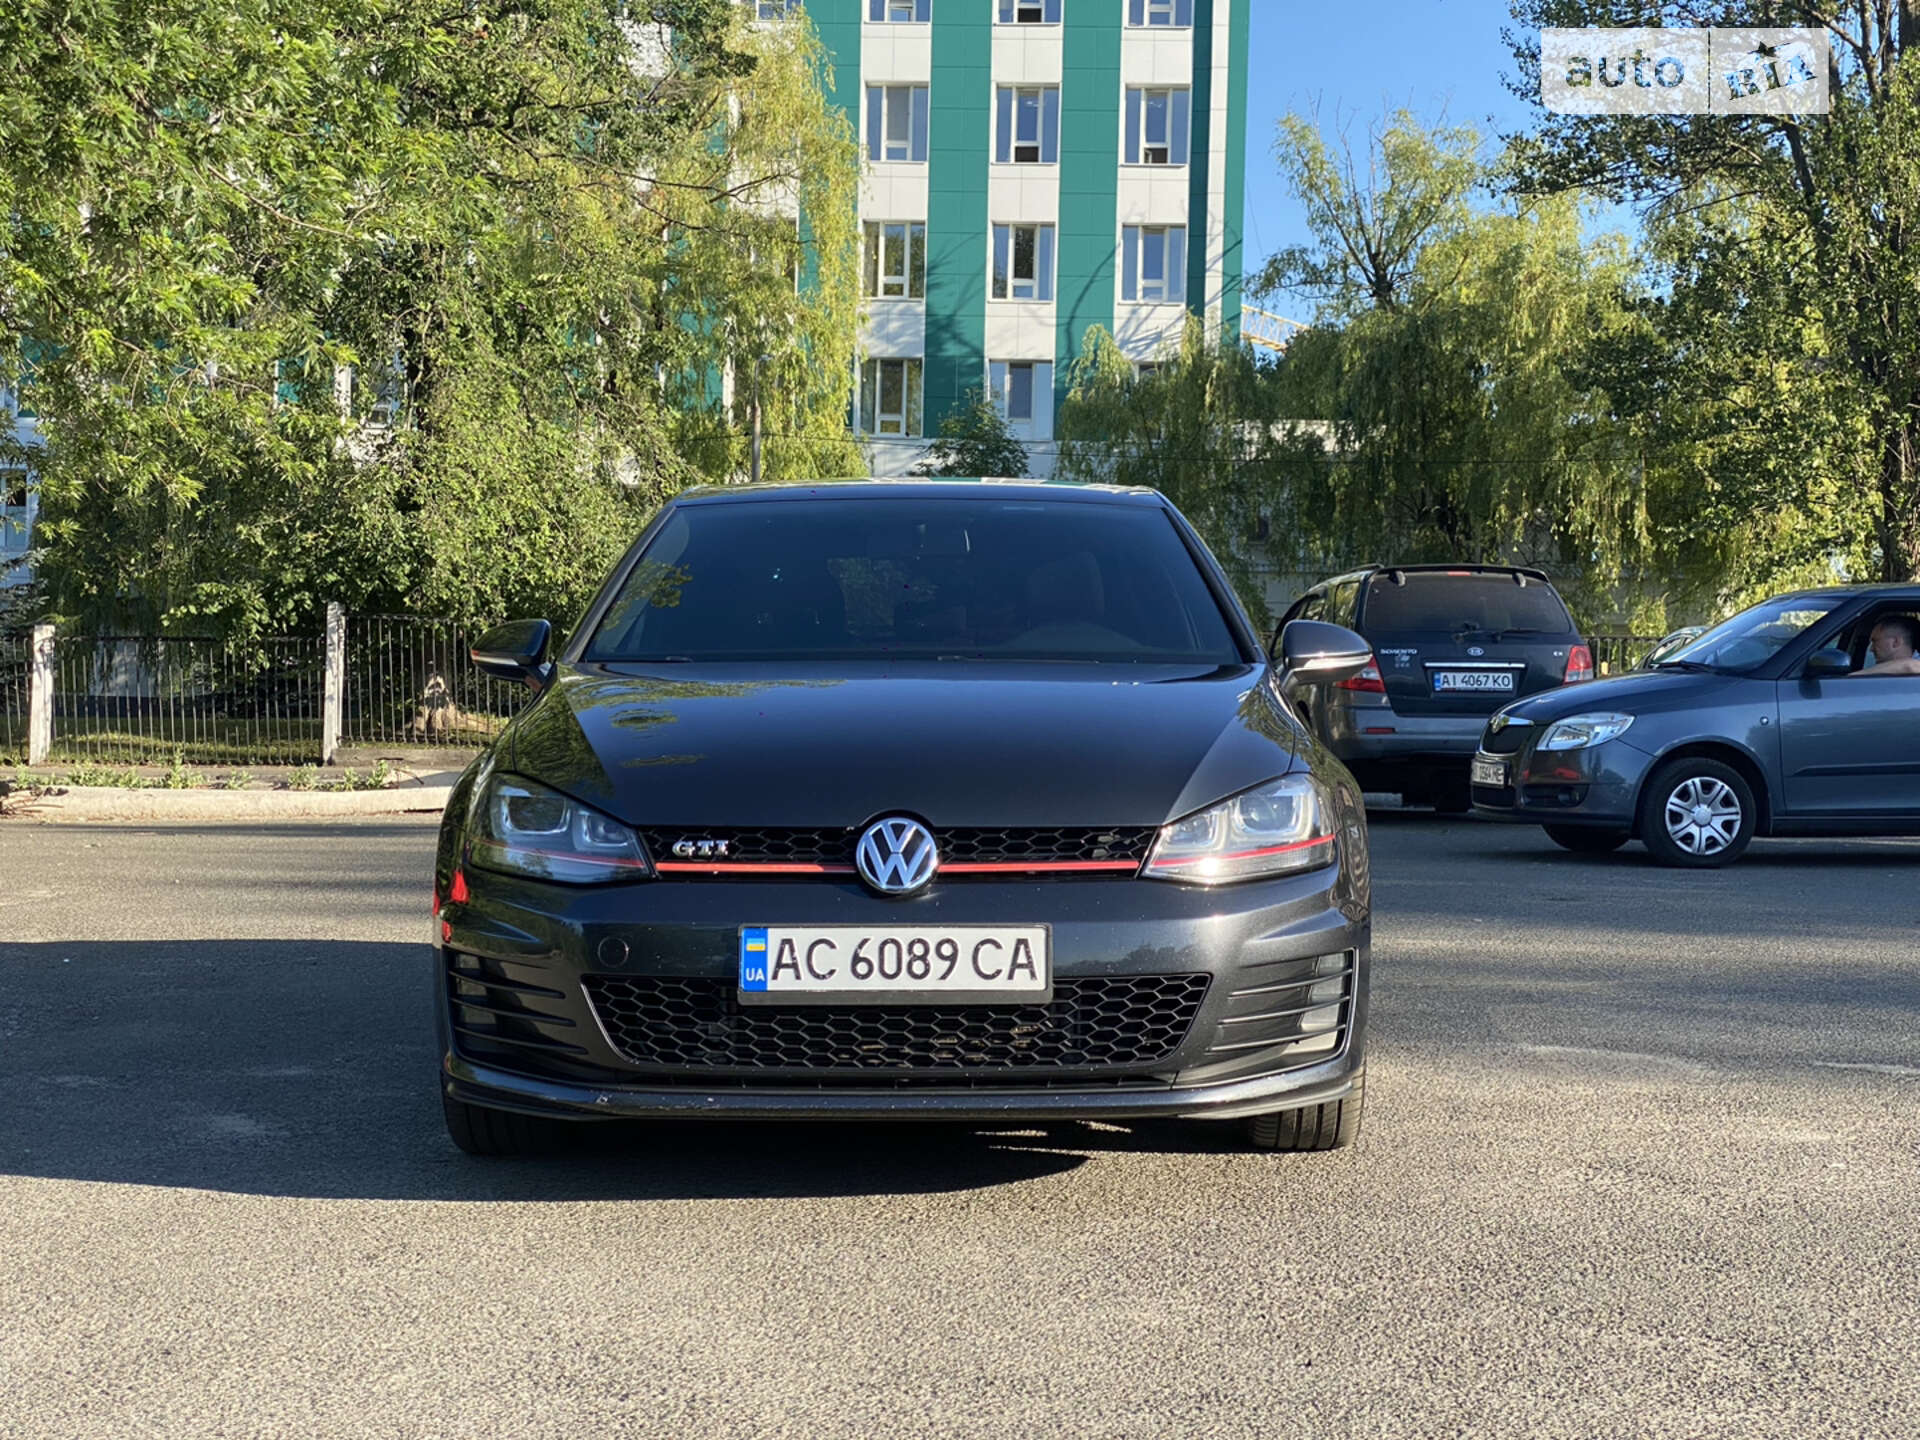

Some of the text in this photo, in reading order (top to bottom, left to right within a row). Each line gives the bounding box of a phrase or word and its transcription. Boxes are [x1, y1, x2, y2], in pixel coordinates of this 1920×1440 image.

[1441, 674, 1511, 688] AI 4067 KO
[671, 839, 729, 857] GTI
[770, 937, 1038, 982] AC 6089 CA
[745, 968, 766, 982] UA
